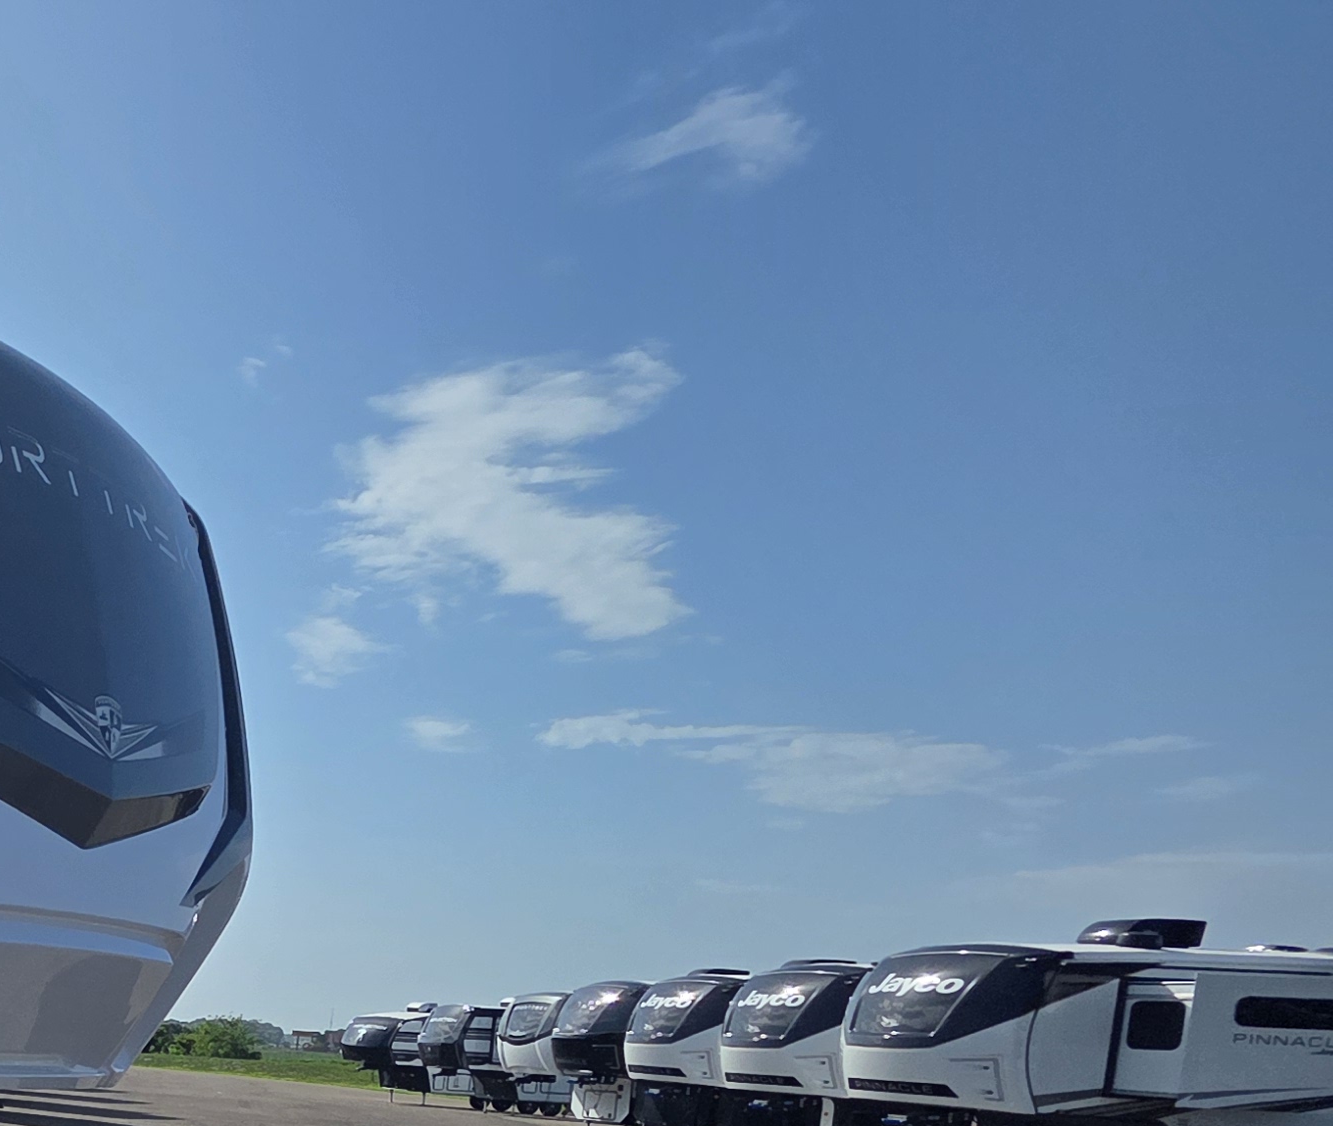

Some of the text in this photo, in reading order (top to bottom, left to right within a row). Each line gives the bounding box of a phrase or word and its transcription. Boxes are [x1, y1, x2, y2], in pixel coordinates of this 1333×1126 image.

[869, 973, 964, 996] Jayco
[641, 993, 692, 1009] Jayco
[738, 990, 805, 1009] Jayco
[854, 1080, 933, 1094] PINNACLE
